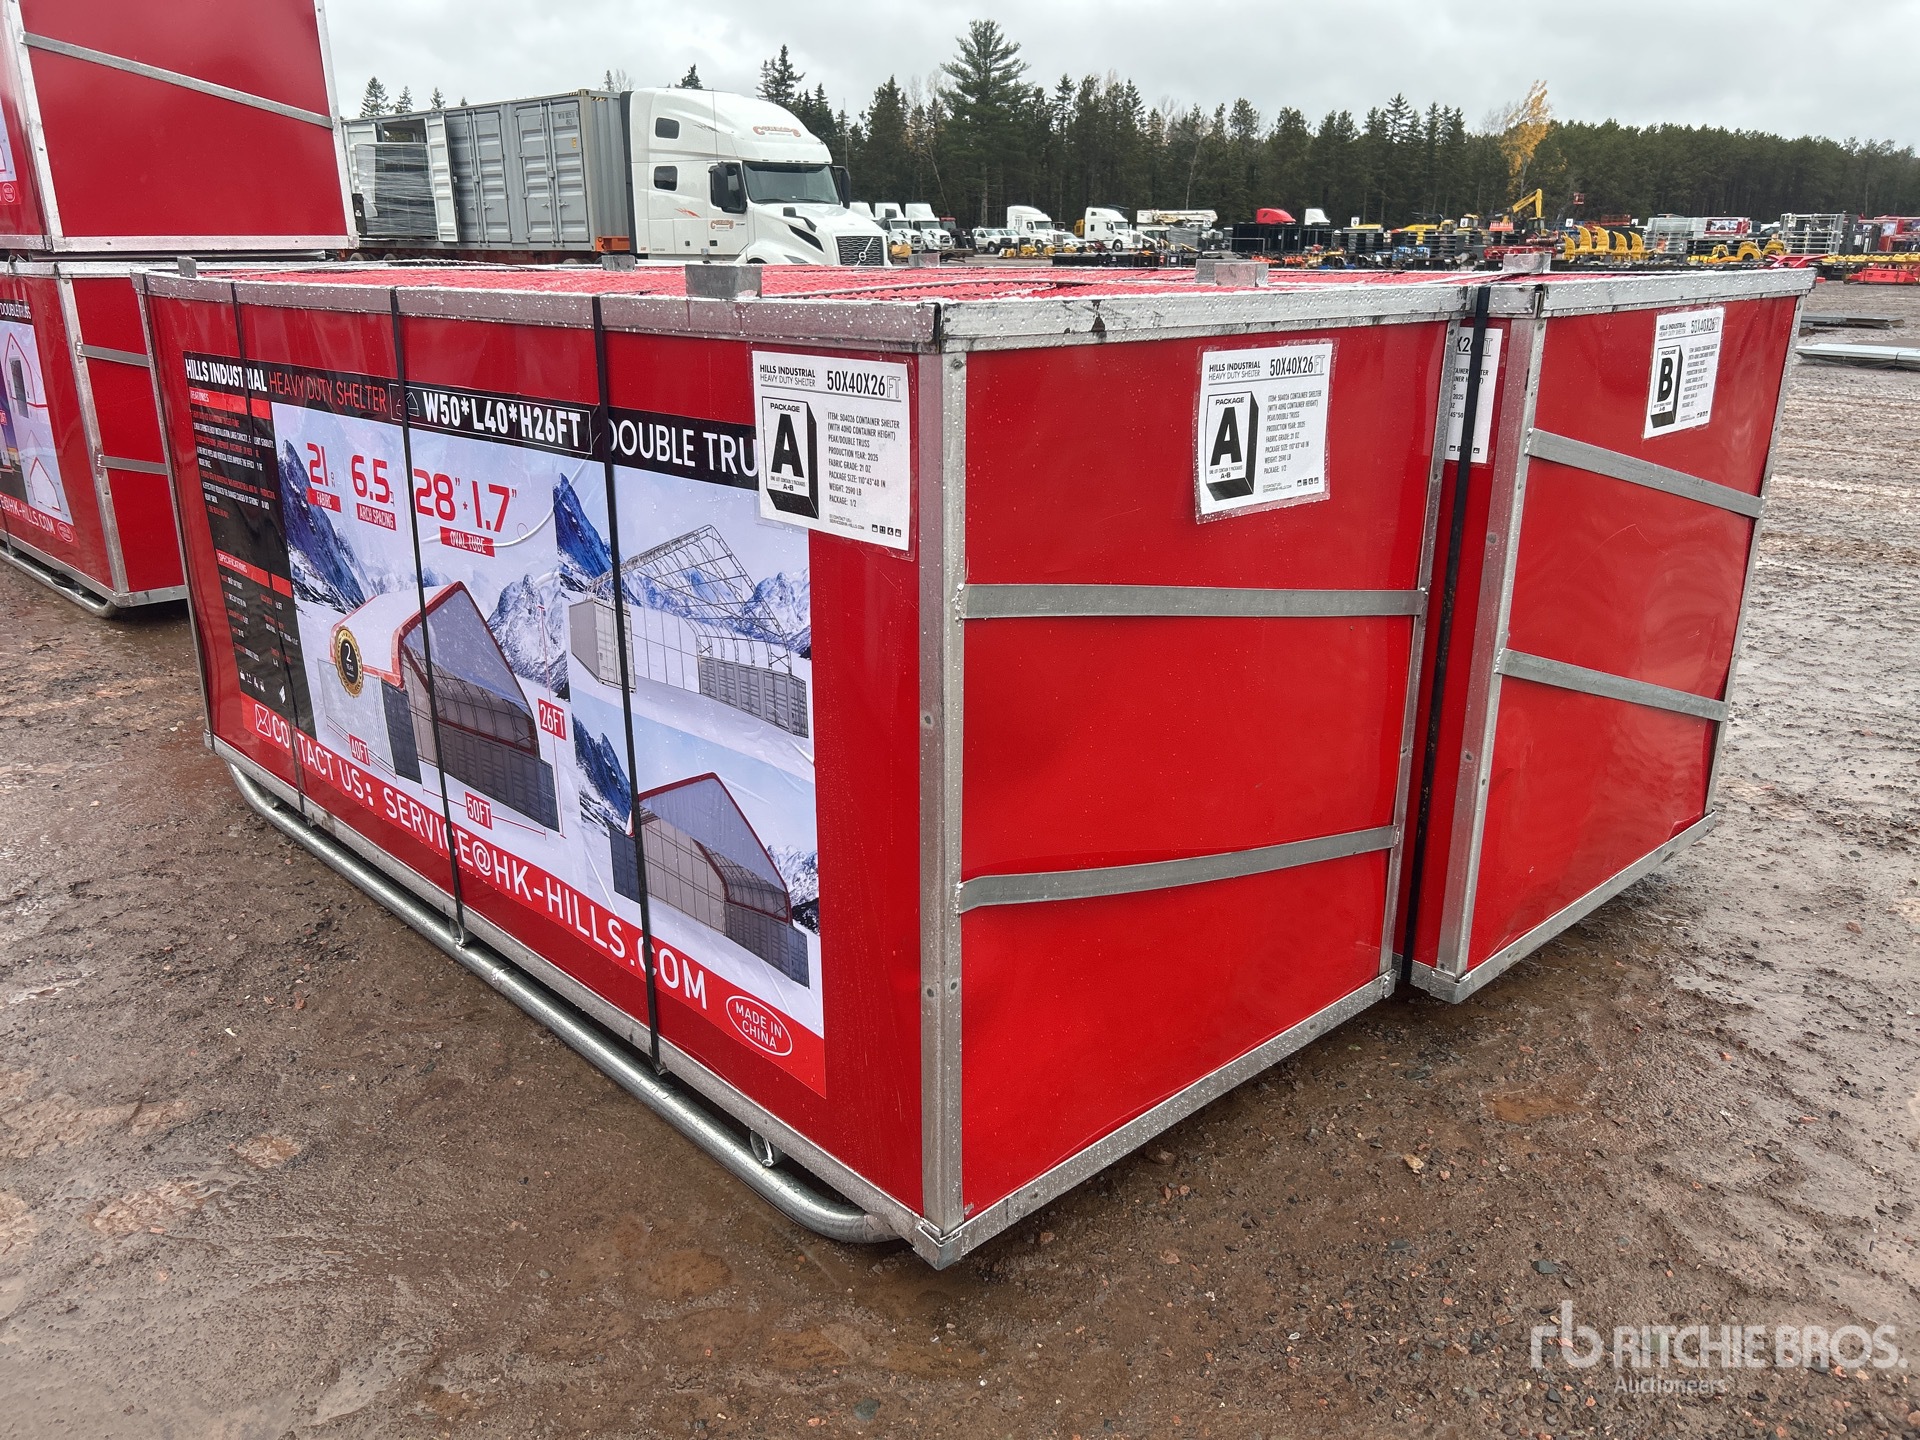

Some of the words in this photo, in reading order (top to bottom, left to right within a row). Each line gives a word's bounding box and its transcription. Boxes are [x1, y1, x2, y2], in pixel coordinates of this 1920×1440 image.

[759, 364, 777, 375] HILLS
[777, 366, 816, 378] INDUSTRIAL
[760, 373, 778, 383] HEAVY
[779, 375, 794, 385] DUTY
[794, 377, 816, 387] SHELTER
[1208, 363, 1226, 372] HILLS
[1226, 360, 1261, 371] INDUSTRIAL
[1208, 372, 1226, 381] HEAVY
[1226, 371, 1240, 380] DUTY
[1241, 369, 1260, 378] SHELTER
[1657, 357, 1674, 403] B
[185, 358, 209, 382] HILLS
[269, 371, 304, 398] HEAVY
[306, 376, 333, 403] DUTY
[336, 381, 387, 413] SHELTER
[1215, 396, 1245, 406] PACKAGE
[769, 402, 801, 413] PACKAGE
[771, 413, 805, 479] A
[1210, 406, 1243, 467] A
[307, 442, 329, 487] 21
[351, 454, 390, 504] 6.5
[540, 703, 564, 737] 26FT
[351, 738, 369, 764] 40FT
[467, 796, 490, 827] 50FT
[272, 715, 334, 781] COTACT
[338, 759, 374, 807] US:
[383, 786, 708, 1011] SERVICE@HK-HILLS.COM
[735, 1001, 767, 1030] MADE
[770, 1021, 782, 1039] IN
[742, 1020, 777, 1050] CHINA
